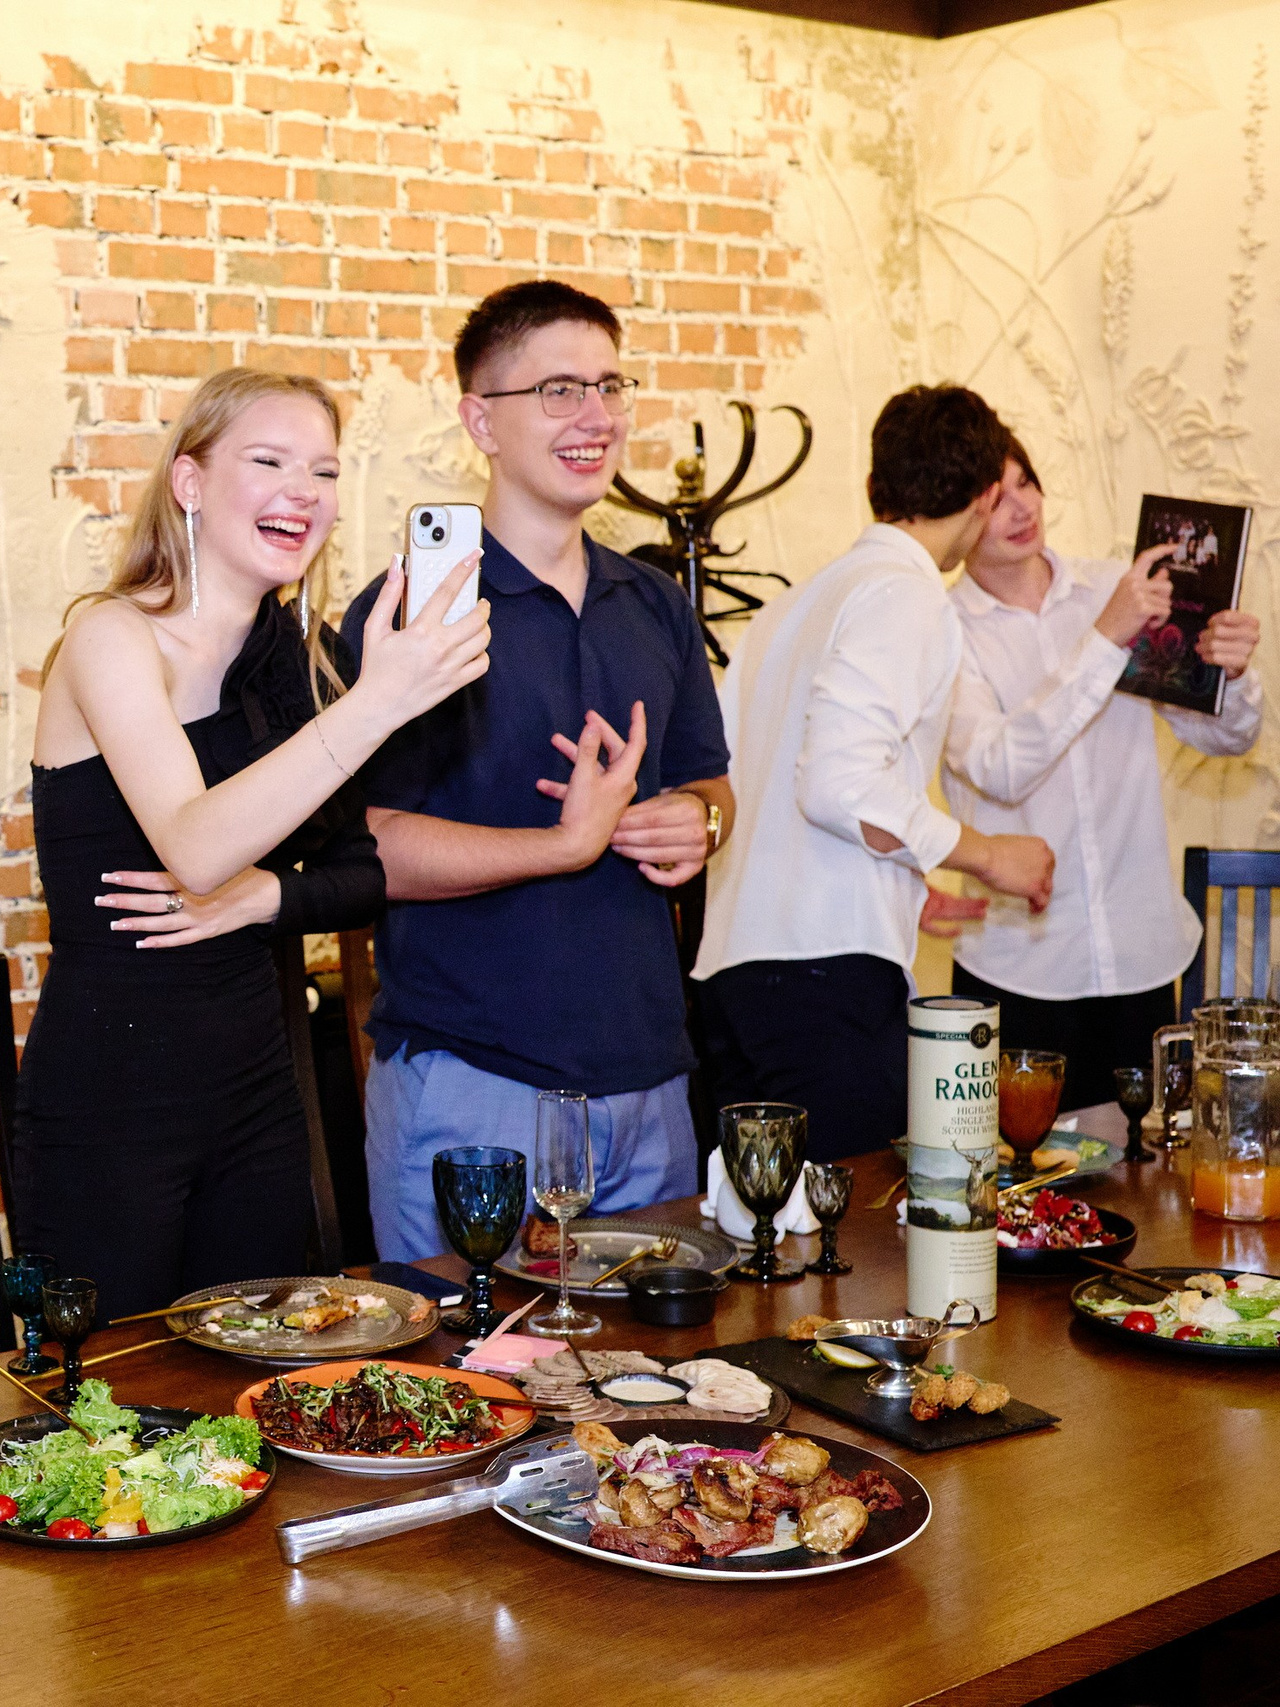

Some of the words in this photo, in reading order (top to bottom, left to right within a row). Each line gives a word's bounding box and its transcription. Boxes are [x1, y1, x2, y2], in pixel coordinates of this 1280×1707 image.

[955, 1060, 998, 1078] GLEN
[951, 1117, 983, 1125] SINGLE
[942, 1126, 980, 1135] SCOTCH
